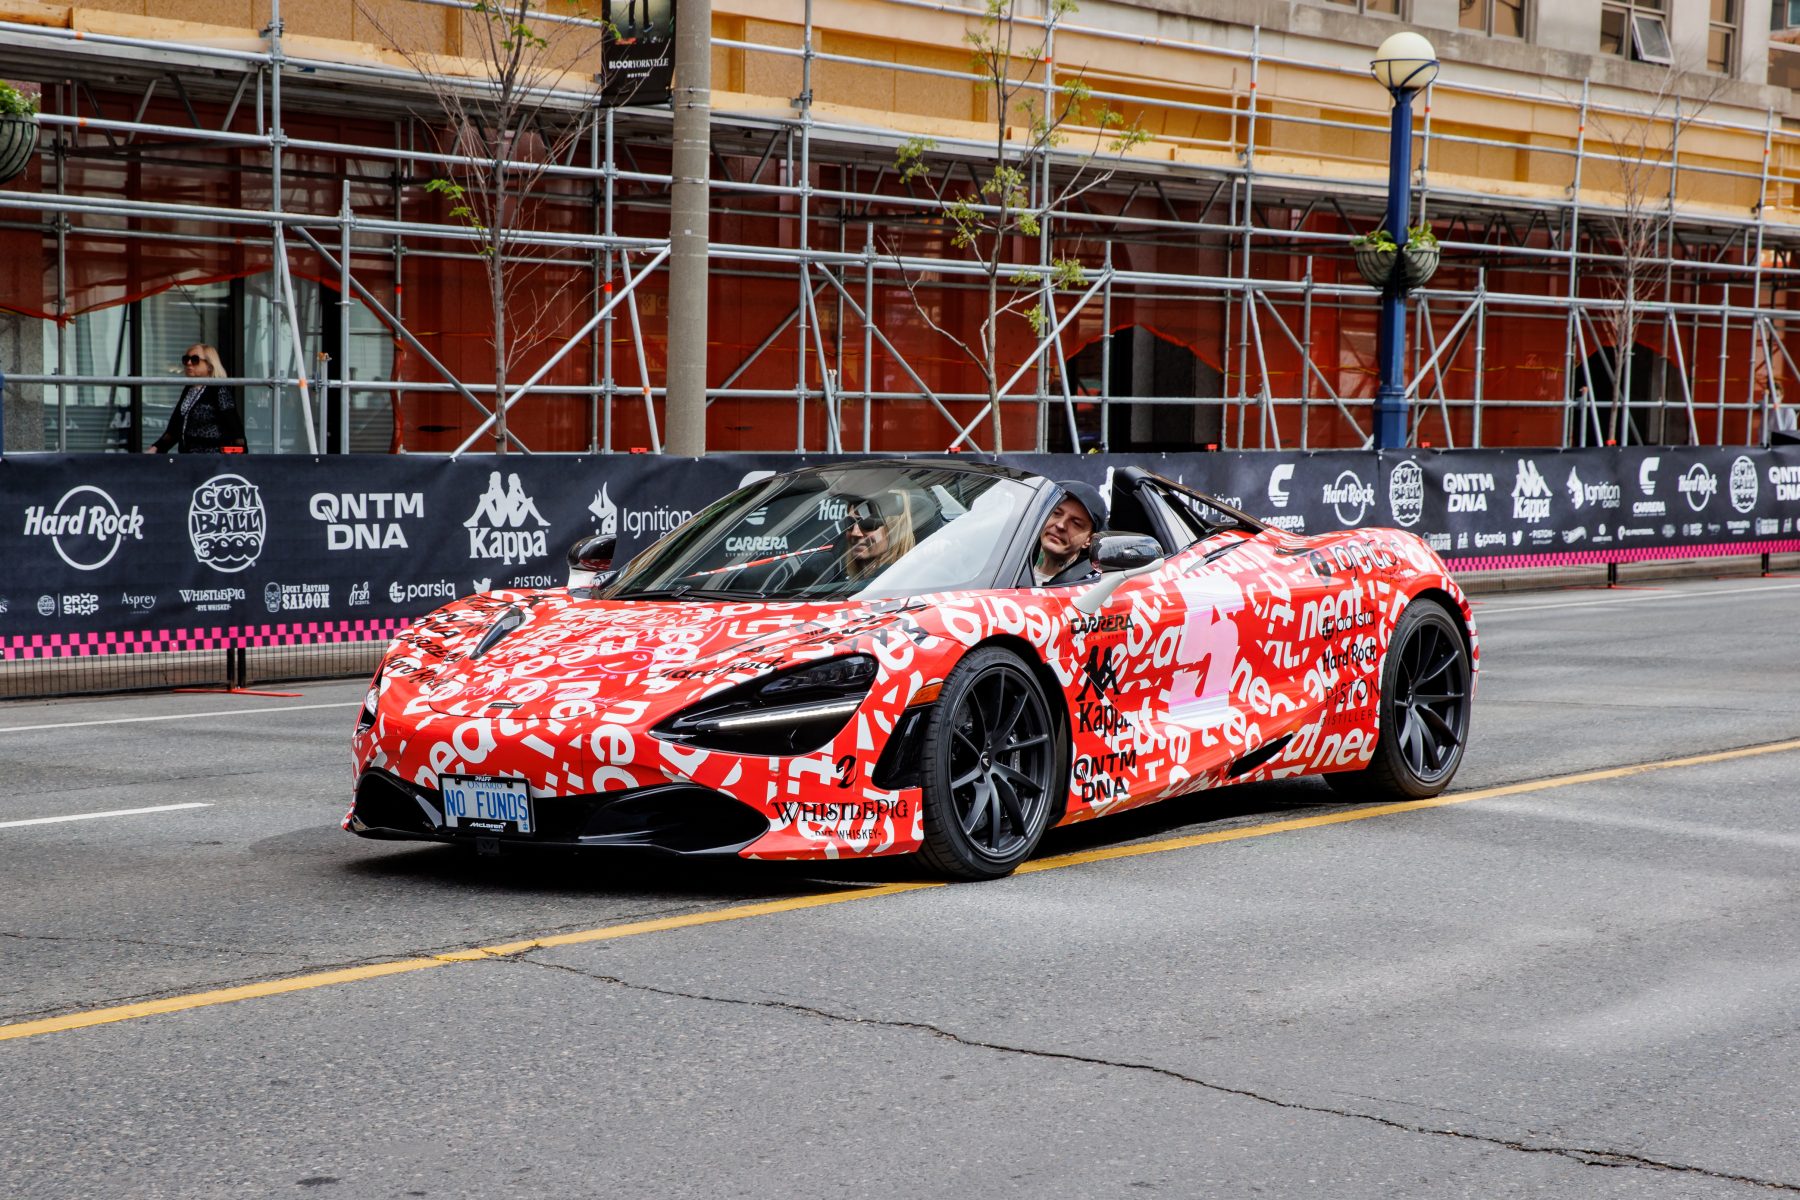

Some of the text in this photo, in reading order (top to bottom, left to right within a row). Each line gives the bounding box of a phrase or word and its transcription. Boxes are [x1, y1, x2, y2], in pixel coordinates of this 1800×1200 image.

[1443, 473, 1495, 494] QNTM
[1768, 465, 1800, 485] QNT
[193, 483, 261, 511] GUM
[1322, 483, 1375, 507] Hard Rock
[1447, 493, 1487, 512] DNA
[1584, 481, 1620, 507] Ignition
[309, 492, 425, 523] QNTM
[1513, 497, 1551, 523] Kappa
[23, 505, 145, 541] Hard Rock
[191, 509, 262, 537] BALL
[327, 523, 409, 551] DNA
[468, 527, 549, 565] Kappa
[725, 535, 789, 552] CARRERA
[281, 584, 330, 593] LUCKY BASTARD
[407, 579, 456, 602] parsiq
[514, 575, 552, 588] PISTON
[63, 593, 99, 605] DROP
[121, 592, 157, 609] Asprey
[179, 588, 246, 602] WHISTLEPIG
[282, 593, 330, 610] SALOON
[63, 604, 99, 615] SHOP
[1070, 613, 1135, 635] CARRERA
[1336, 607, 1375, 638] parsiq
[1322, 638, 1377, 673] Hard Rock
[1325, 677, 1380, 708] PISTON
[1073, 749, 1137, 783] QNTM
[467, 781, 503, 790] ONTARIO
[1081, 776, 1129, 803] DNA
[445, 789, 528, 821] NO FUNDS
[771, 798, 909, 827] WHISTLEPIG
[469, 822, 504, 830] McLaren
